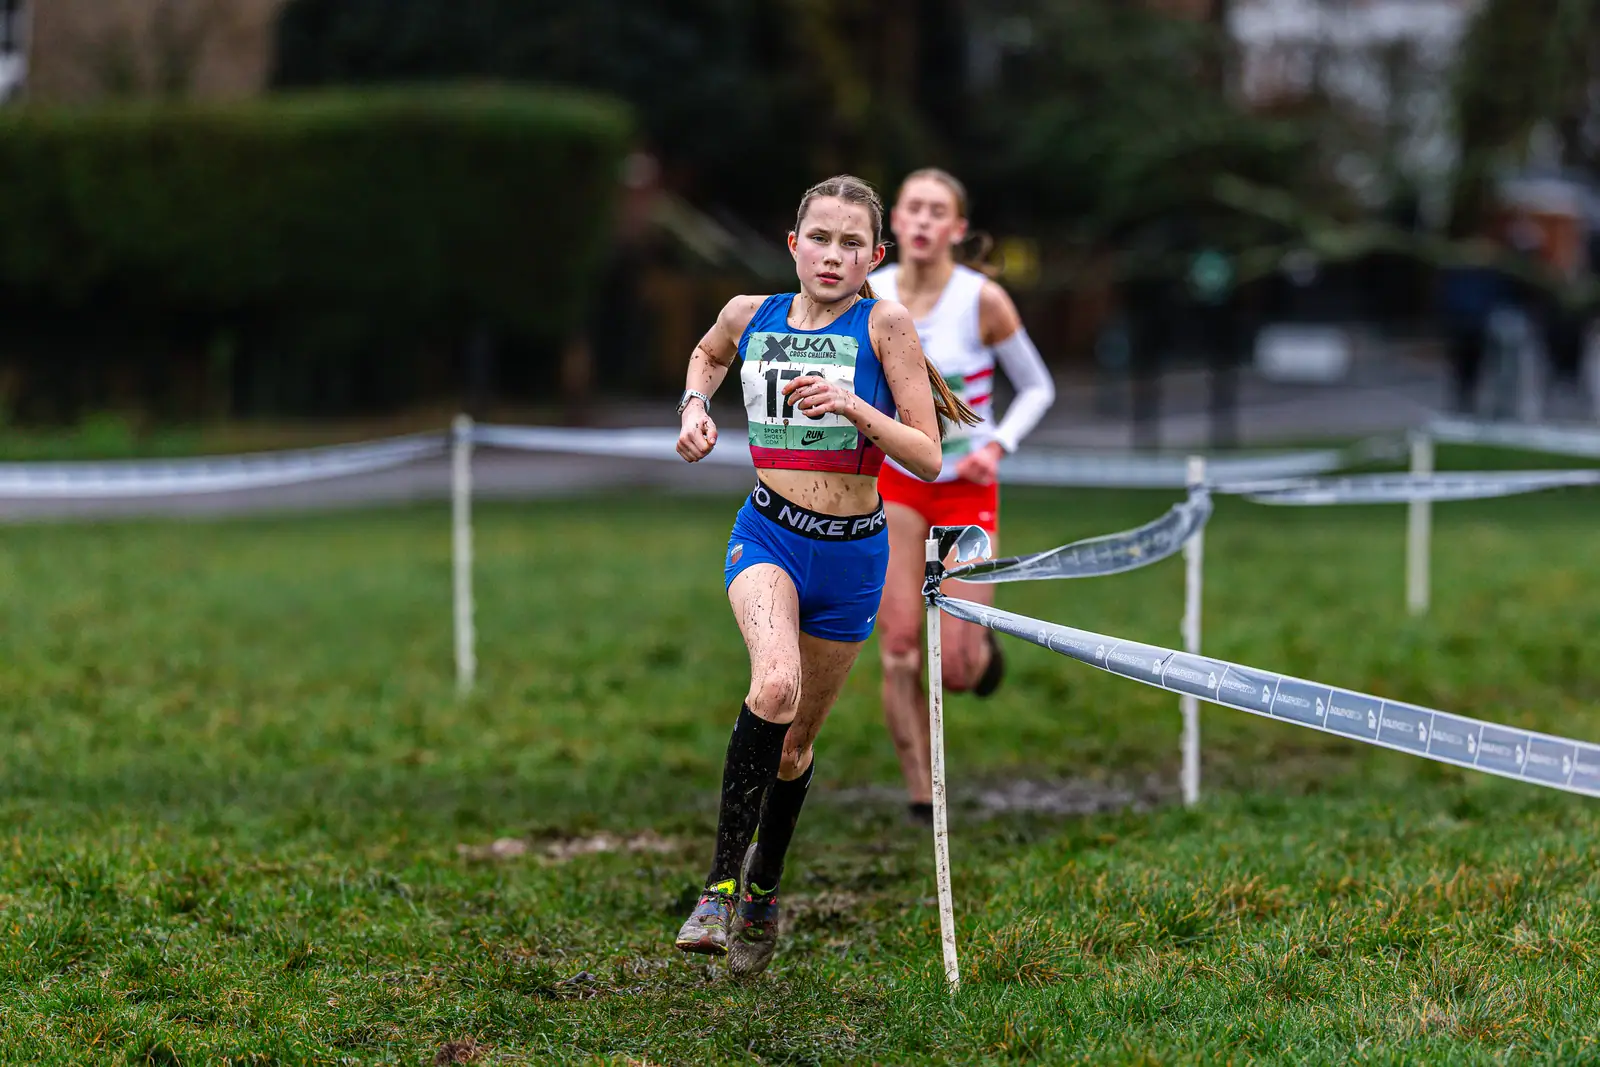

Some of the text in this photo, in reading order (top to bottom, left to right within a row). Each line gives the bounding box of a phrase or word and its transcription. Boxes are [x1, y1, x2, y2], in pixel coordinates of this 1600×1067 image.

[792, 337, 836, 352] UKA
[808, 351, 837, 359] CHALLENGE
[805, 430, 825, 439] RUN
[778, 505, 848, 536] NIKE
